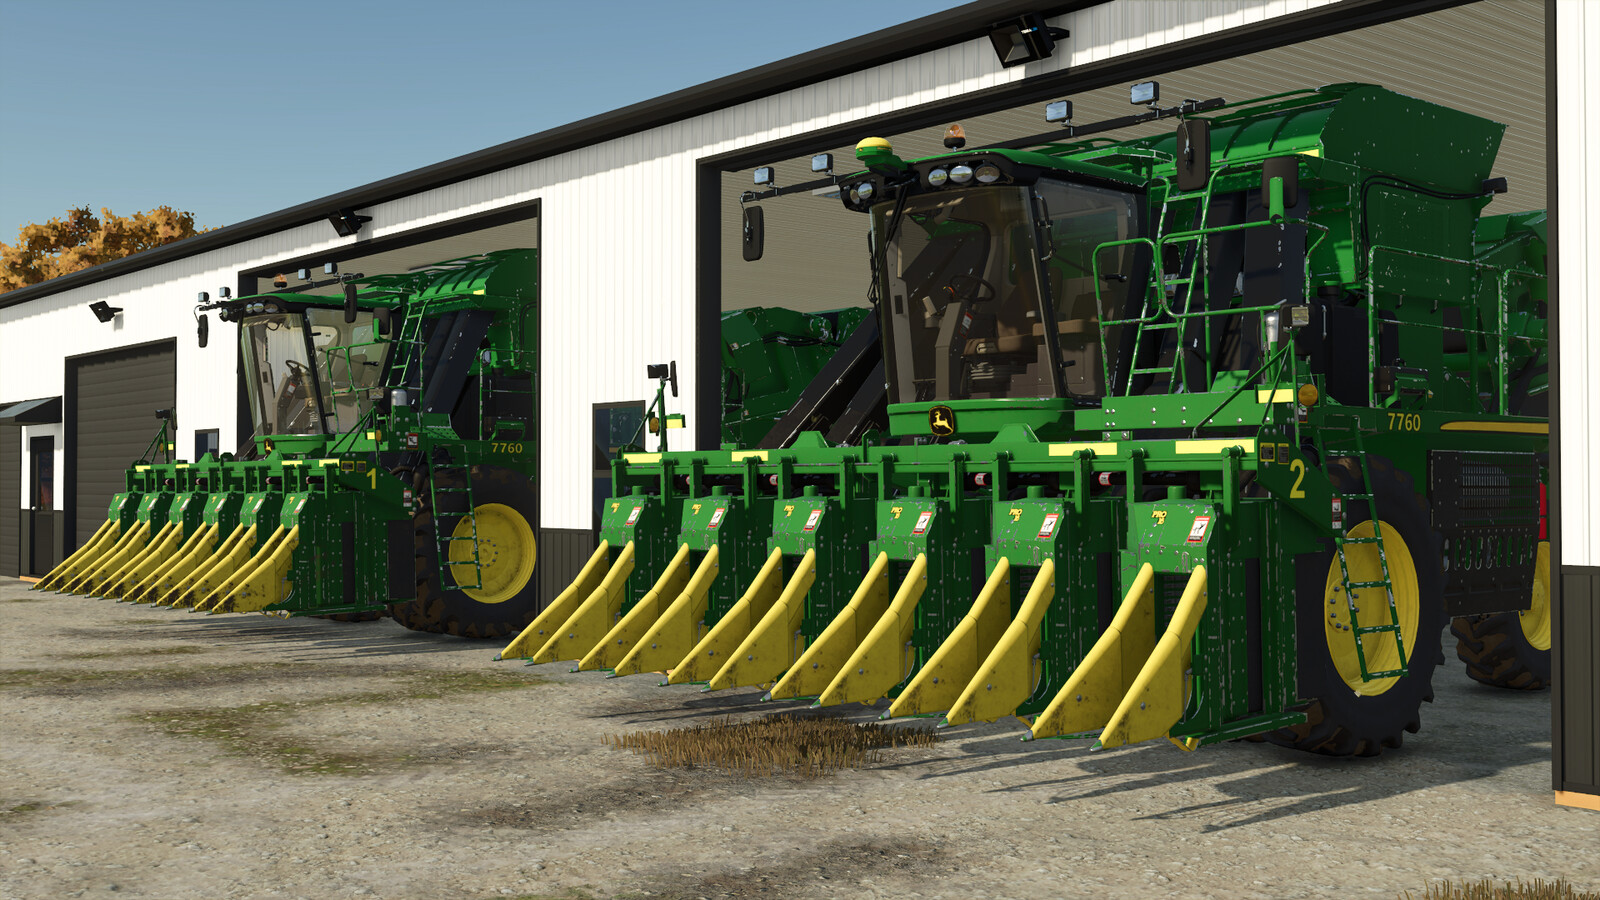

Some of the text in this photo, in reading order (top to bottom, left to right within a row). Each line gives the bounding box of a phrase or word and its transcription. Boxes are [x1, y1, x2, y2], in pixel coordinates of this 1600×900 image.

[1387, 412, 1421, 432] 7760
[491, 442, 523, 453] 7760
[366, 467, 377, 490] 1
[1289, 458, 1306, 499] 2
[1151, 510, 1168, 518] PRO
